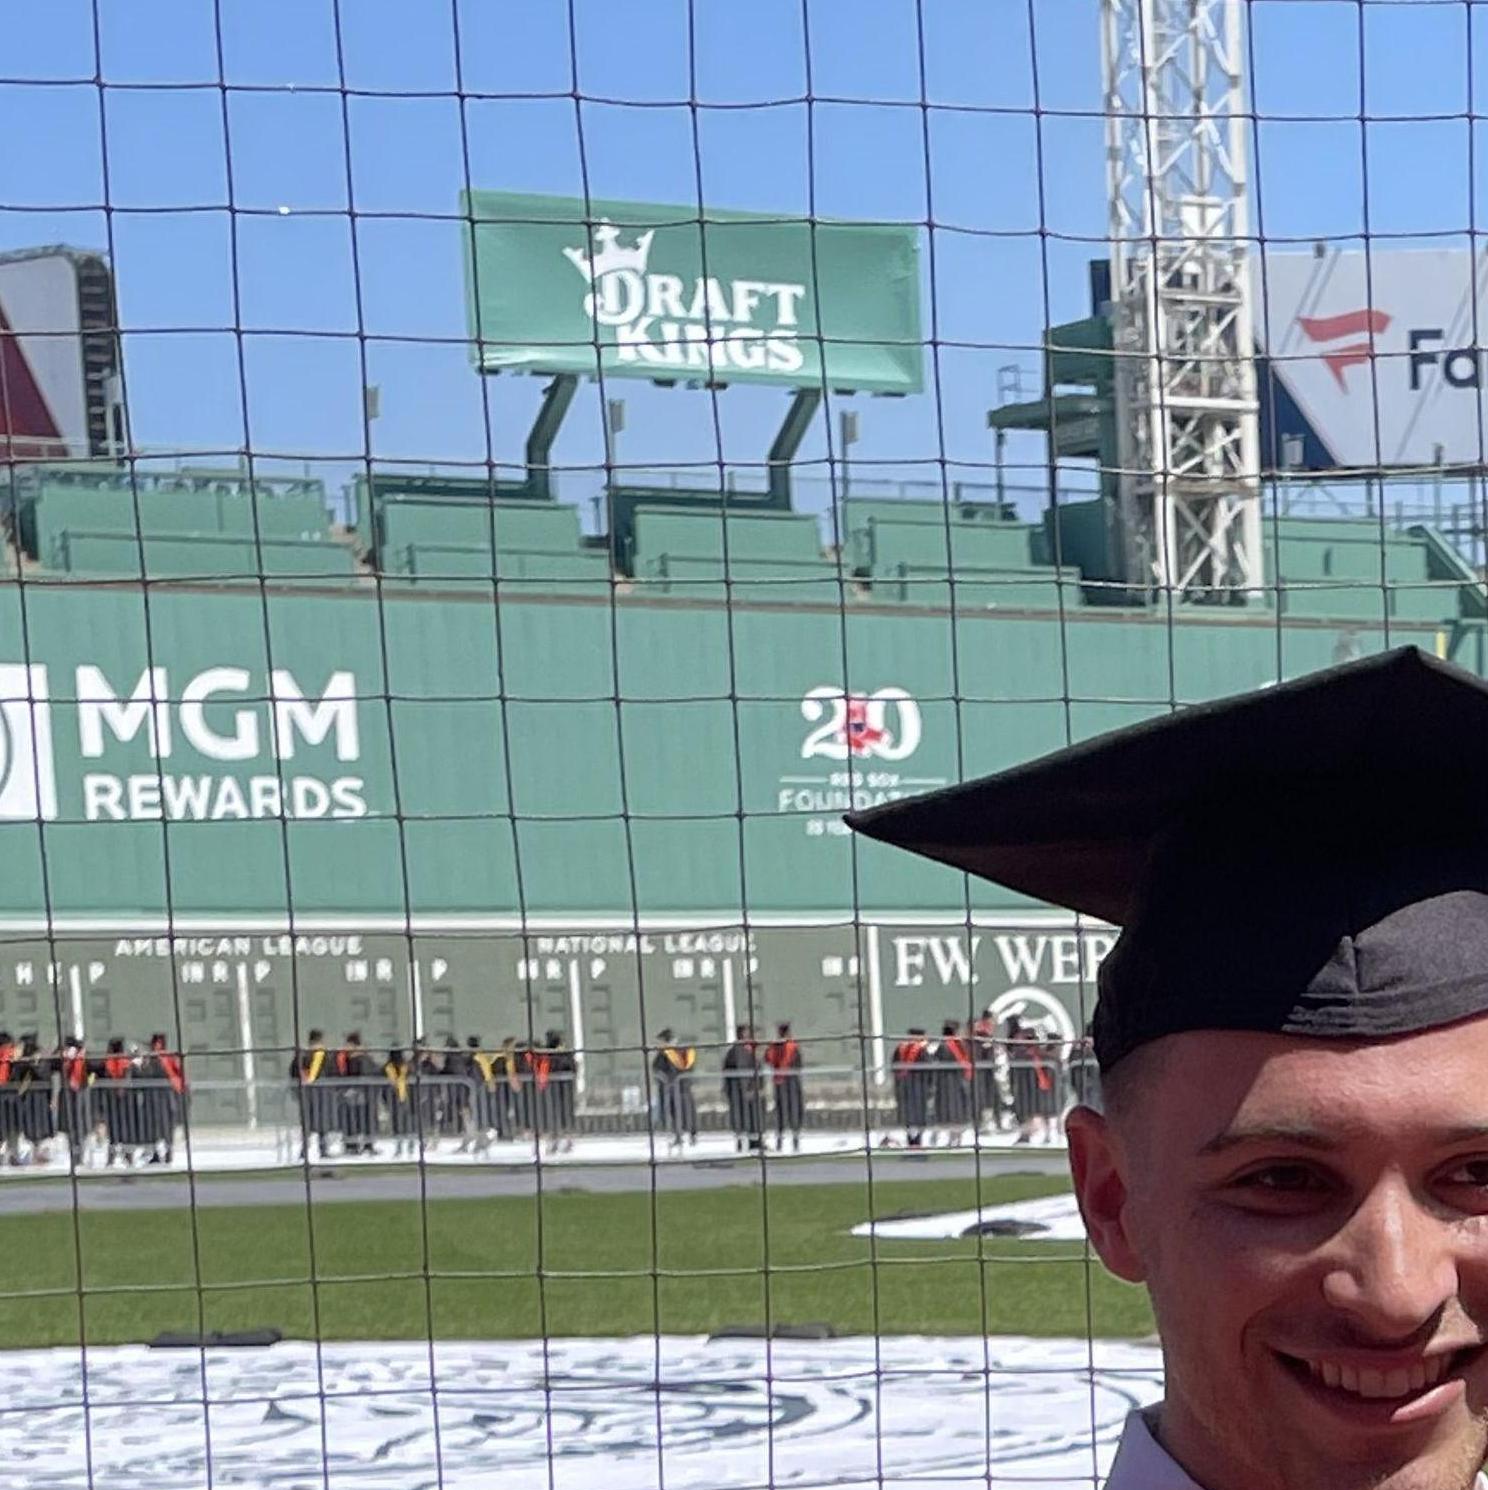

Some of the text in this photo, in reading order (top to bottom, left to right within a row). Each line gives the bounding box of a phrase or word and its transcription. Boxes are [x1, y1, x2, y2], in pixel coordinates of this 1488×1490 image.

[584, 269, 805, 326] DRAFT
[616, 316, 804, 373] KINGS
[76, 664, 360, 762] MGM
[83, 774, 368, 822] REWARDS
[115, 936, 363, 957] AMERICAN LEAGUE
[537, 934, 756, 954] NATIONAL LEAGUE
